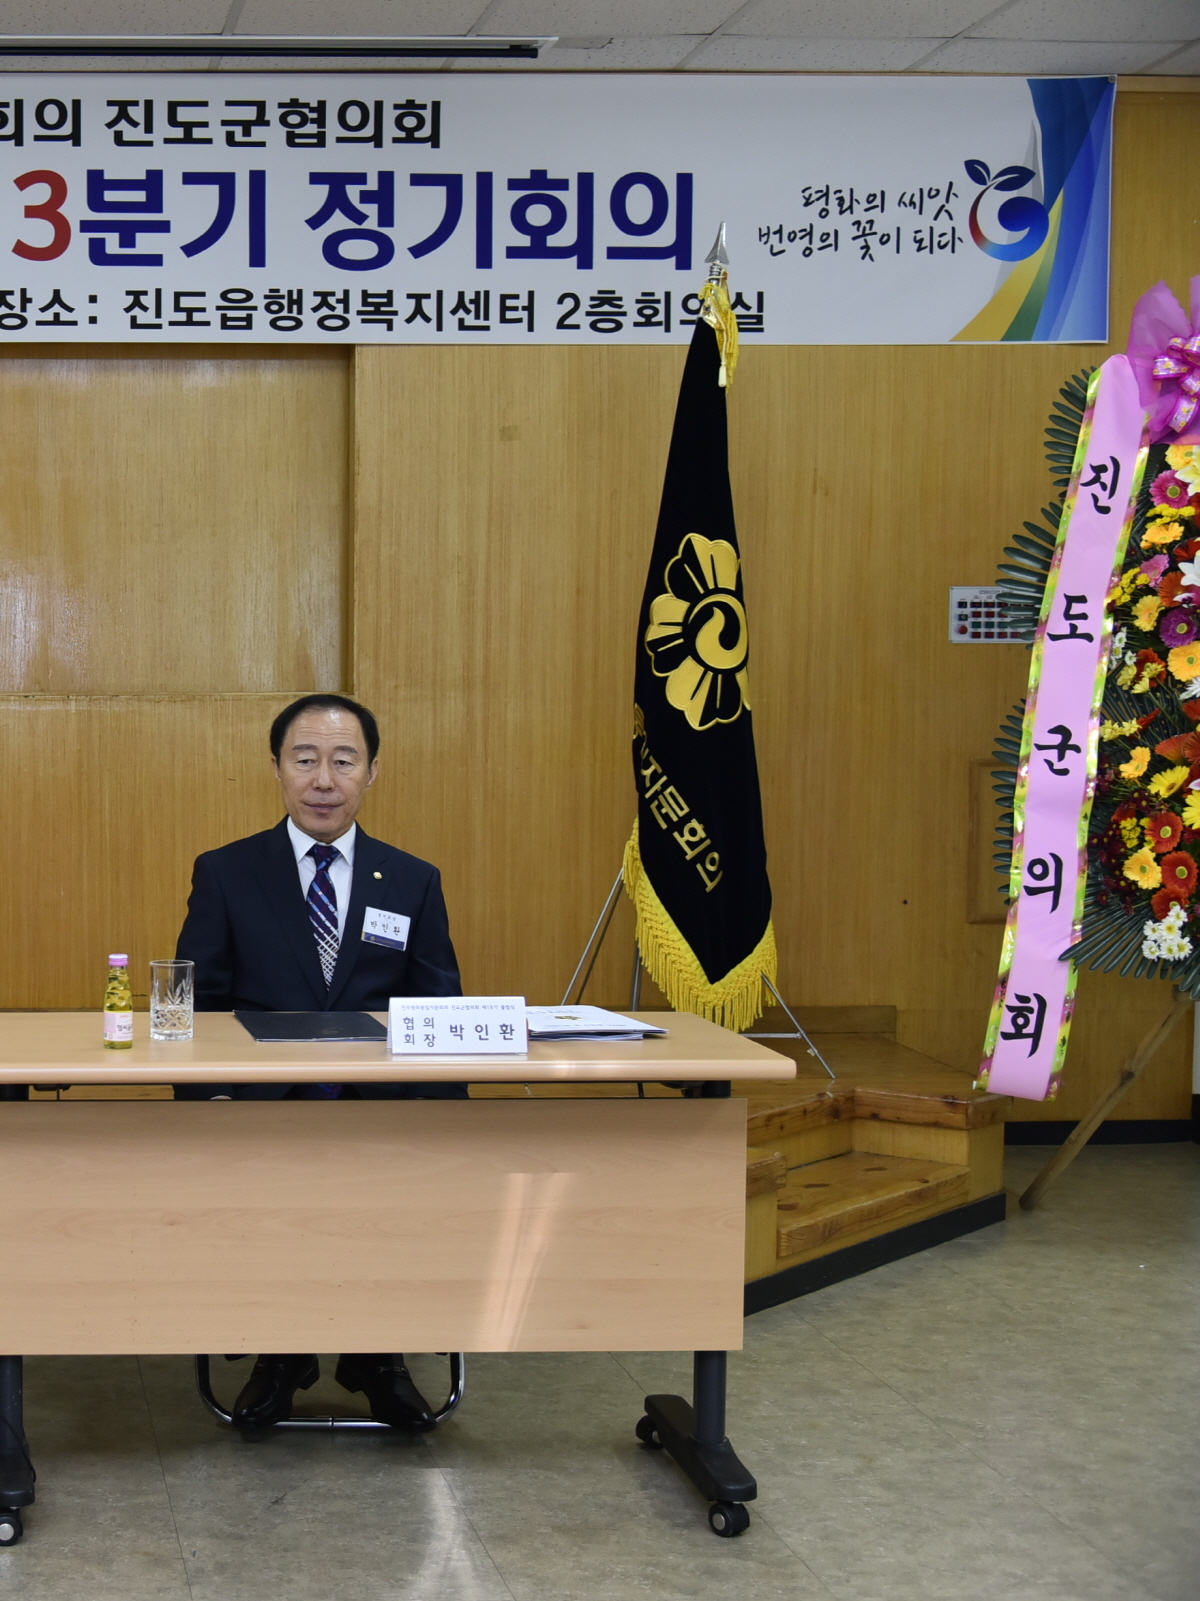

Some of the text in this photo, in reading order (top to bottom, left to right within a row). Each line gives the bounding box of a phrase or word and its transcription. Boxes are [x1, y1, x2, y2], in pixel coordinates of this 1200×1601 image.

[104, 97, 443, 149] 진도군협의회
[11, 169, 267, 268] 3분기
[304, 169, 694, 271] 정기회의
[801, 181, 959, 221] 평화의 씨앗
[758, 219, 964, 262] 번영의 꽃이 되다
[123, 287, 535, 333] 진도읍행정복지센터
[1000, 455, 1122, 1059] 진도군의회
[633, 702, 724, 893] 자문회의
[402, 1016, 435, 1031] 협의
[403, 1033, 437, 1048] 회장
[449, 1022, 516, 1041] 박인환
